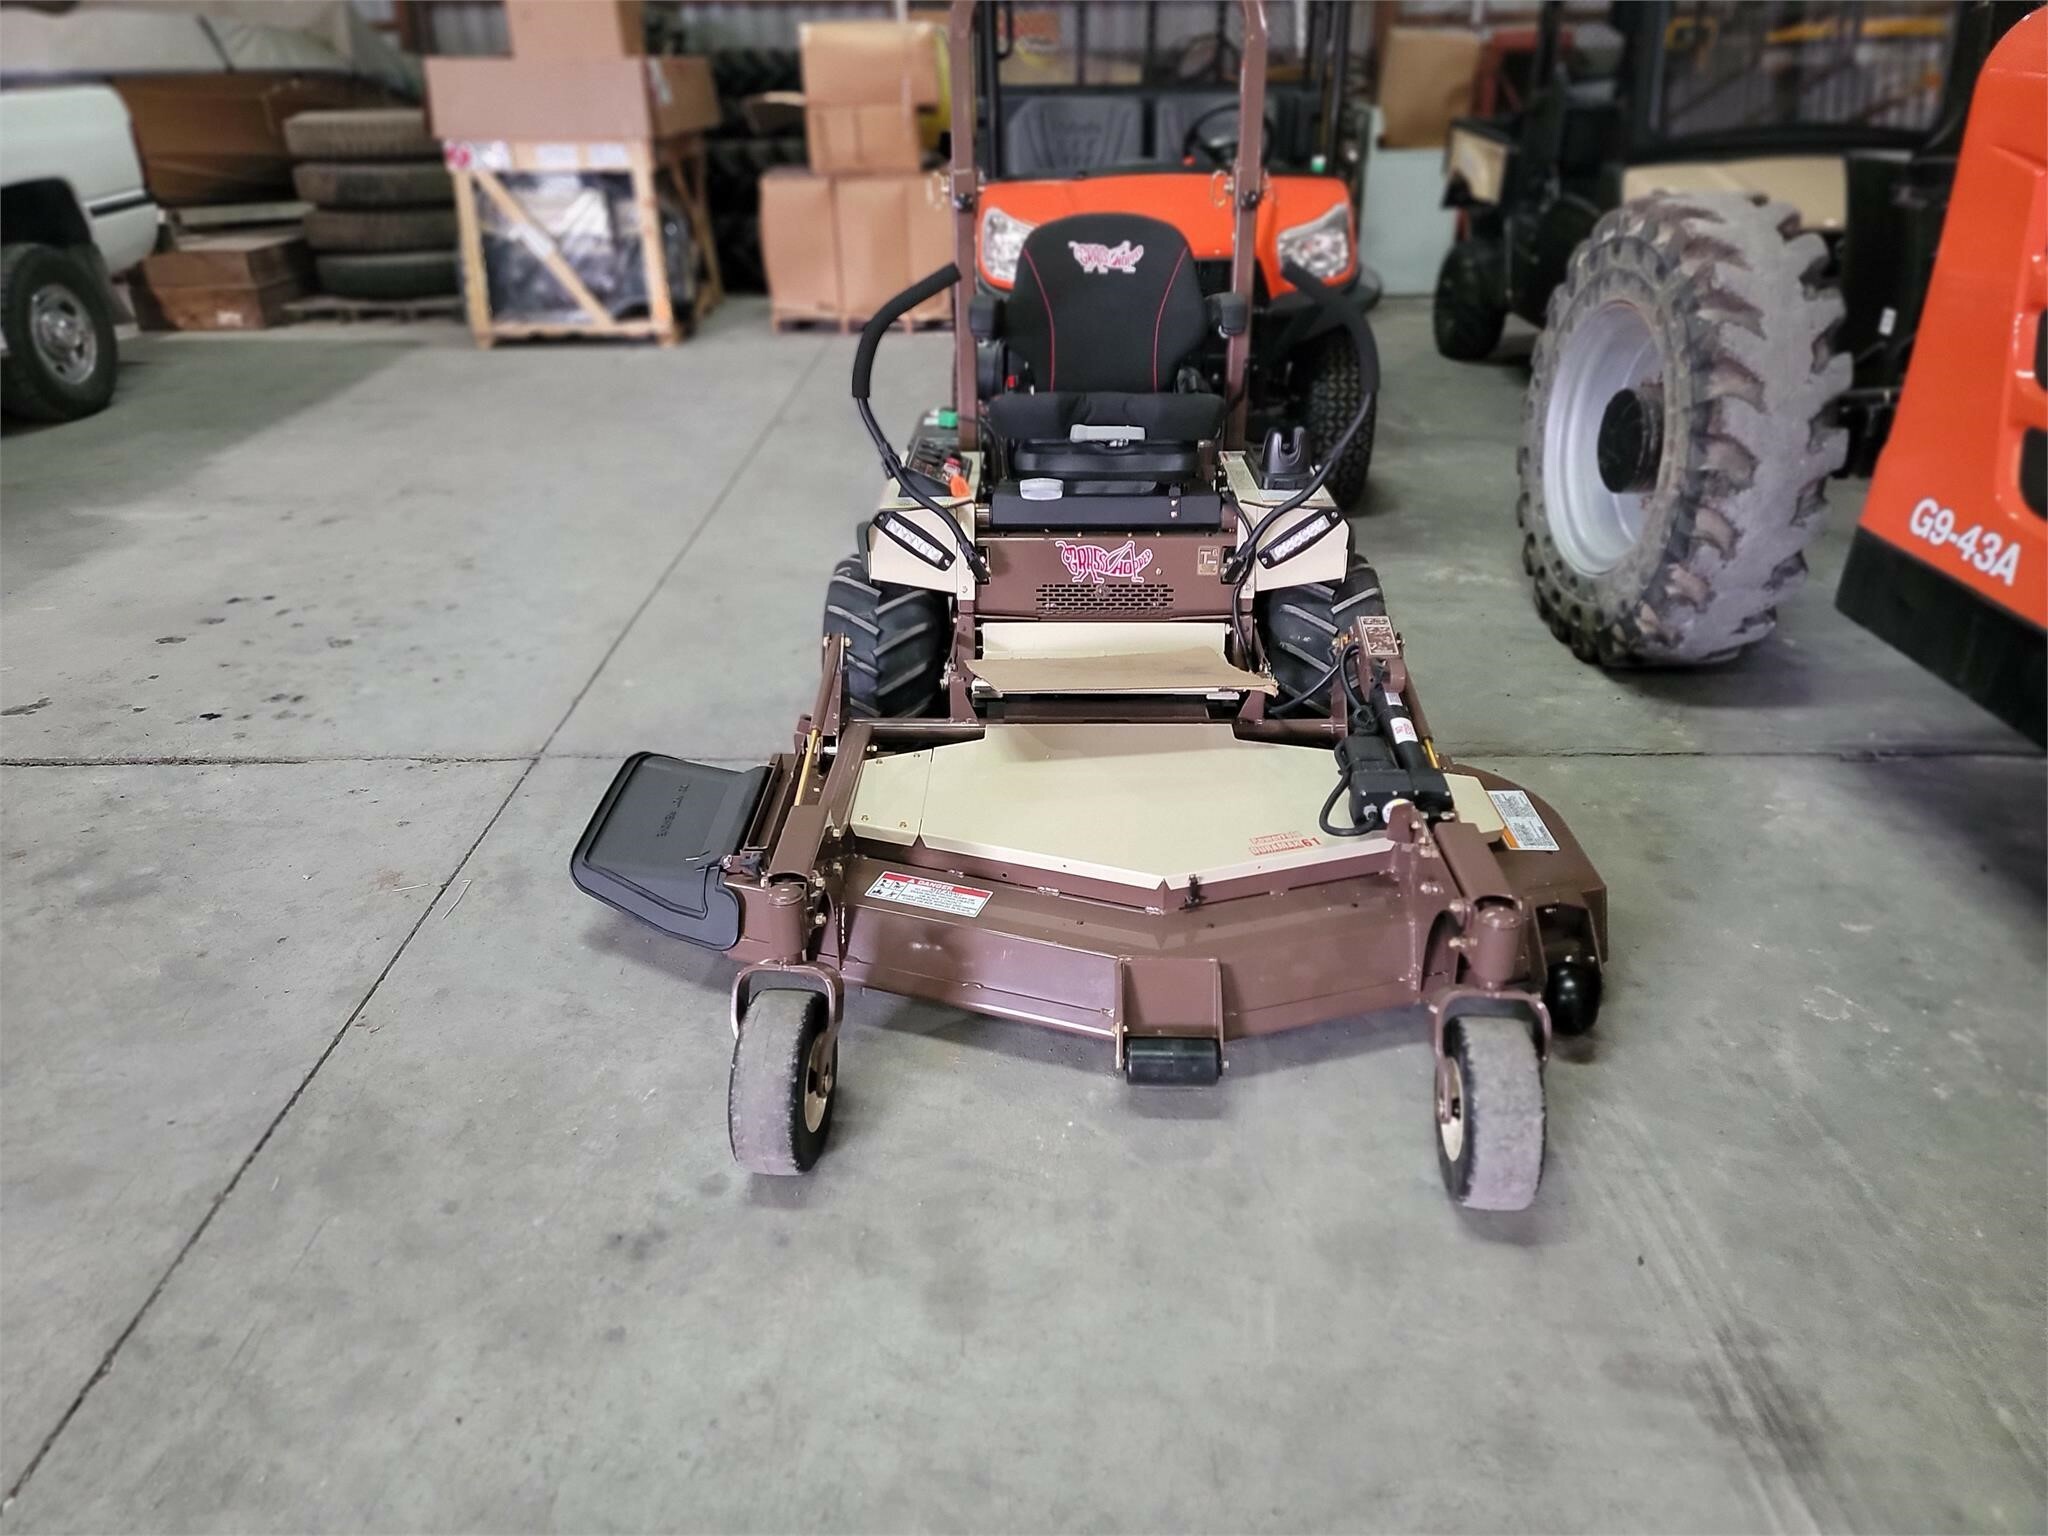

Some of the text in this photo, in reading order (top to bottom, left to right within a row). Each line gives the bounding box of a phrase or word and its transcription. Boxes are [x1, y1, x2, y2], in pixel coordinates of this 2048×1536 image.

[1910, 498, 2021, 587] G9-43A
[1301, 837, 1321, 848] 61
[917, 880, 954, 891] DANGER
